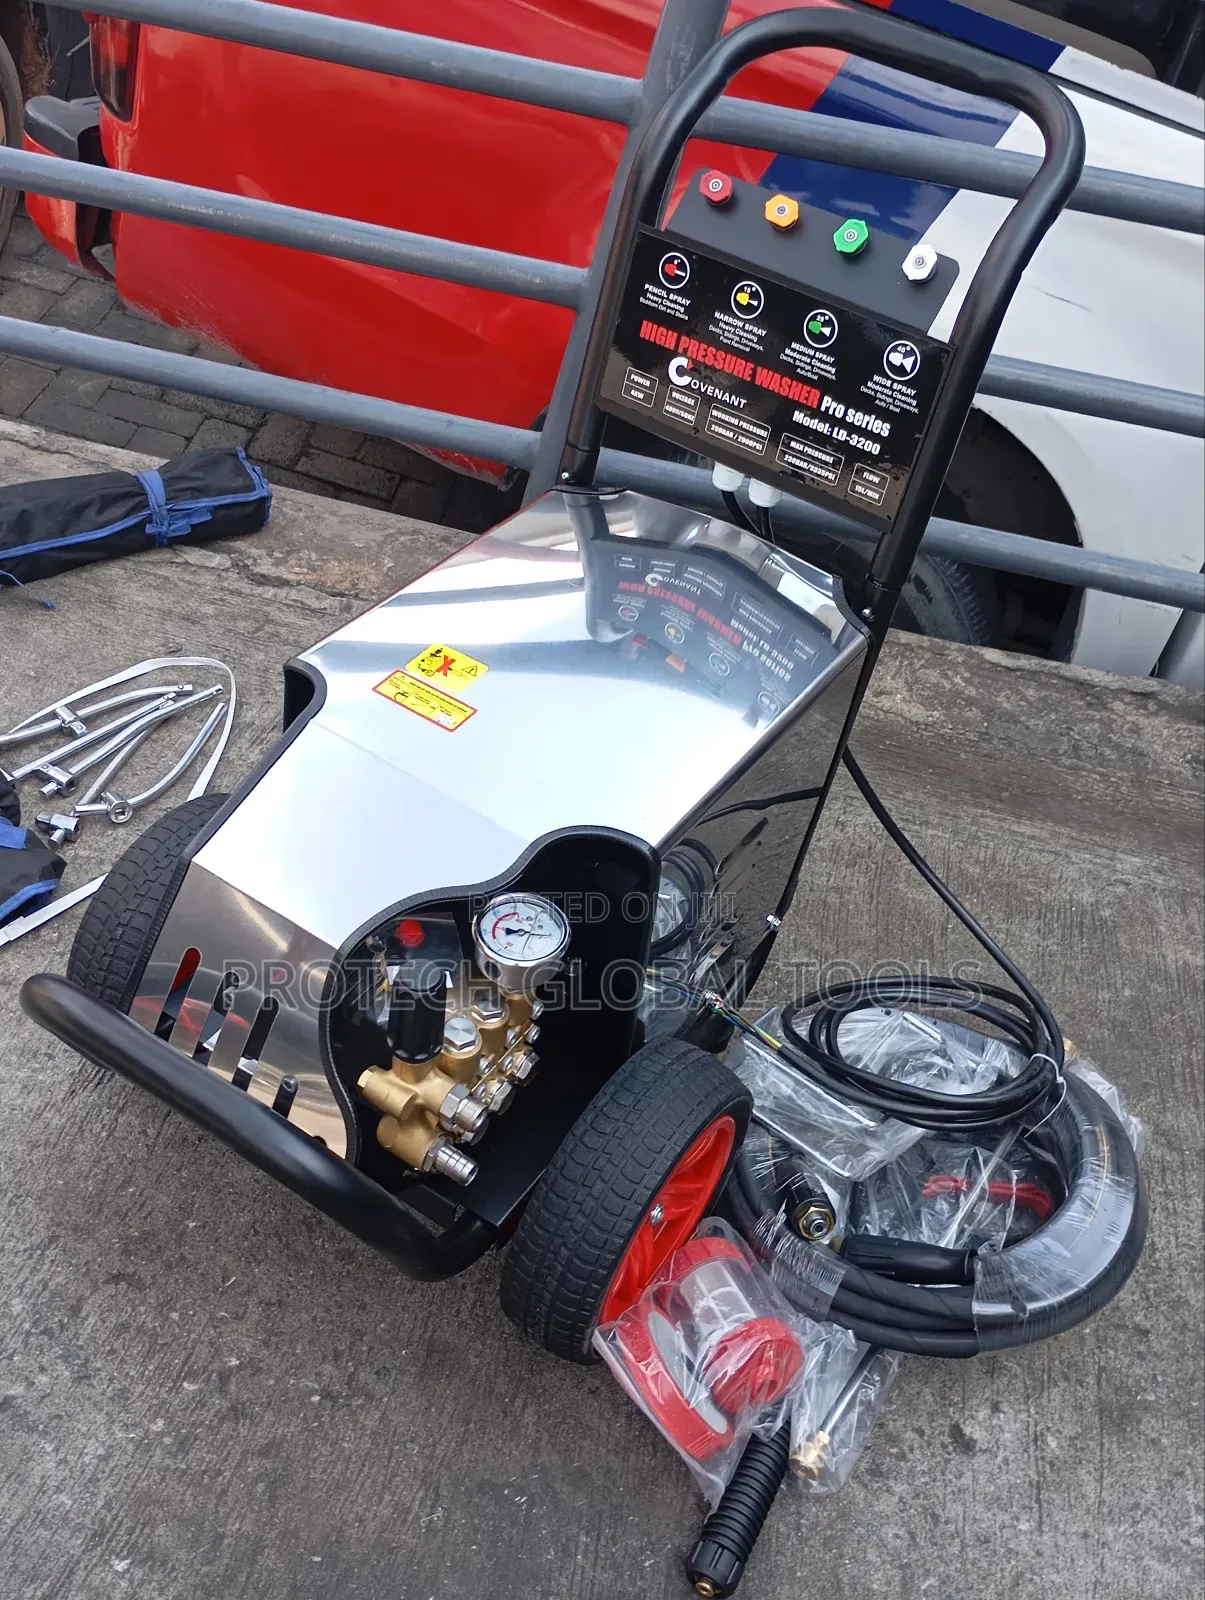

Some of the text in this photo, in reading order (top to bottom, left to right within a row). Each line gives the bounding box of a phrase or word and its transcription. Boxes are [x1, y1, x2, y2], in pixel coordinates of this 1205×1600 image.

[644, 283, 691, 307] PENCIL SPRAY
[646, 292, 685, 313] Heavy Cleaning
[714, 311, 767, 337] NARROW SPRAY
[719, 322, 758, 342] Heavy Cleaning
[784, 348, 836, 374] Moderate Cleaning
[791, 341, 835, 364] MEDIUM SPRAY
[630, 374, 651, 388] POWER
[640, 319, 891, 438] HIGH PRESSURE WASHER Pro series
[668, 356, 748, 409] COVENANT
[872, 374, 917, 397] WIDE SPRAY
[630, 390, 644, 400] 4KW
[672, 391, 696, 406] VOLTAGE
[866, 381, 917, 406] Moderate Cleaning
[710, 424, 734, 440] 200BAR
[712, 408, 768, 438] WORKING PRESSURE
[792, 410, 881, 456] Model: LD-3200
[790, 440, 835, 464] MAX PRESSURE
[862, 472, 881, 484] FLOW
